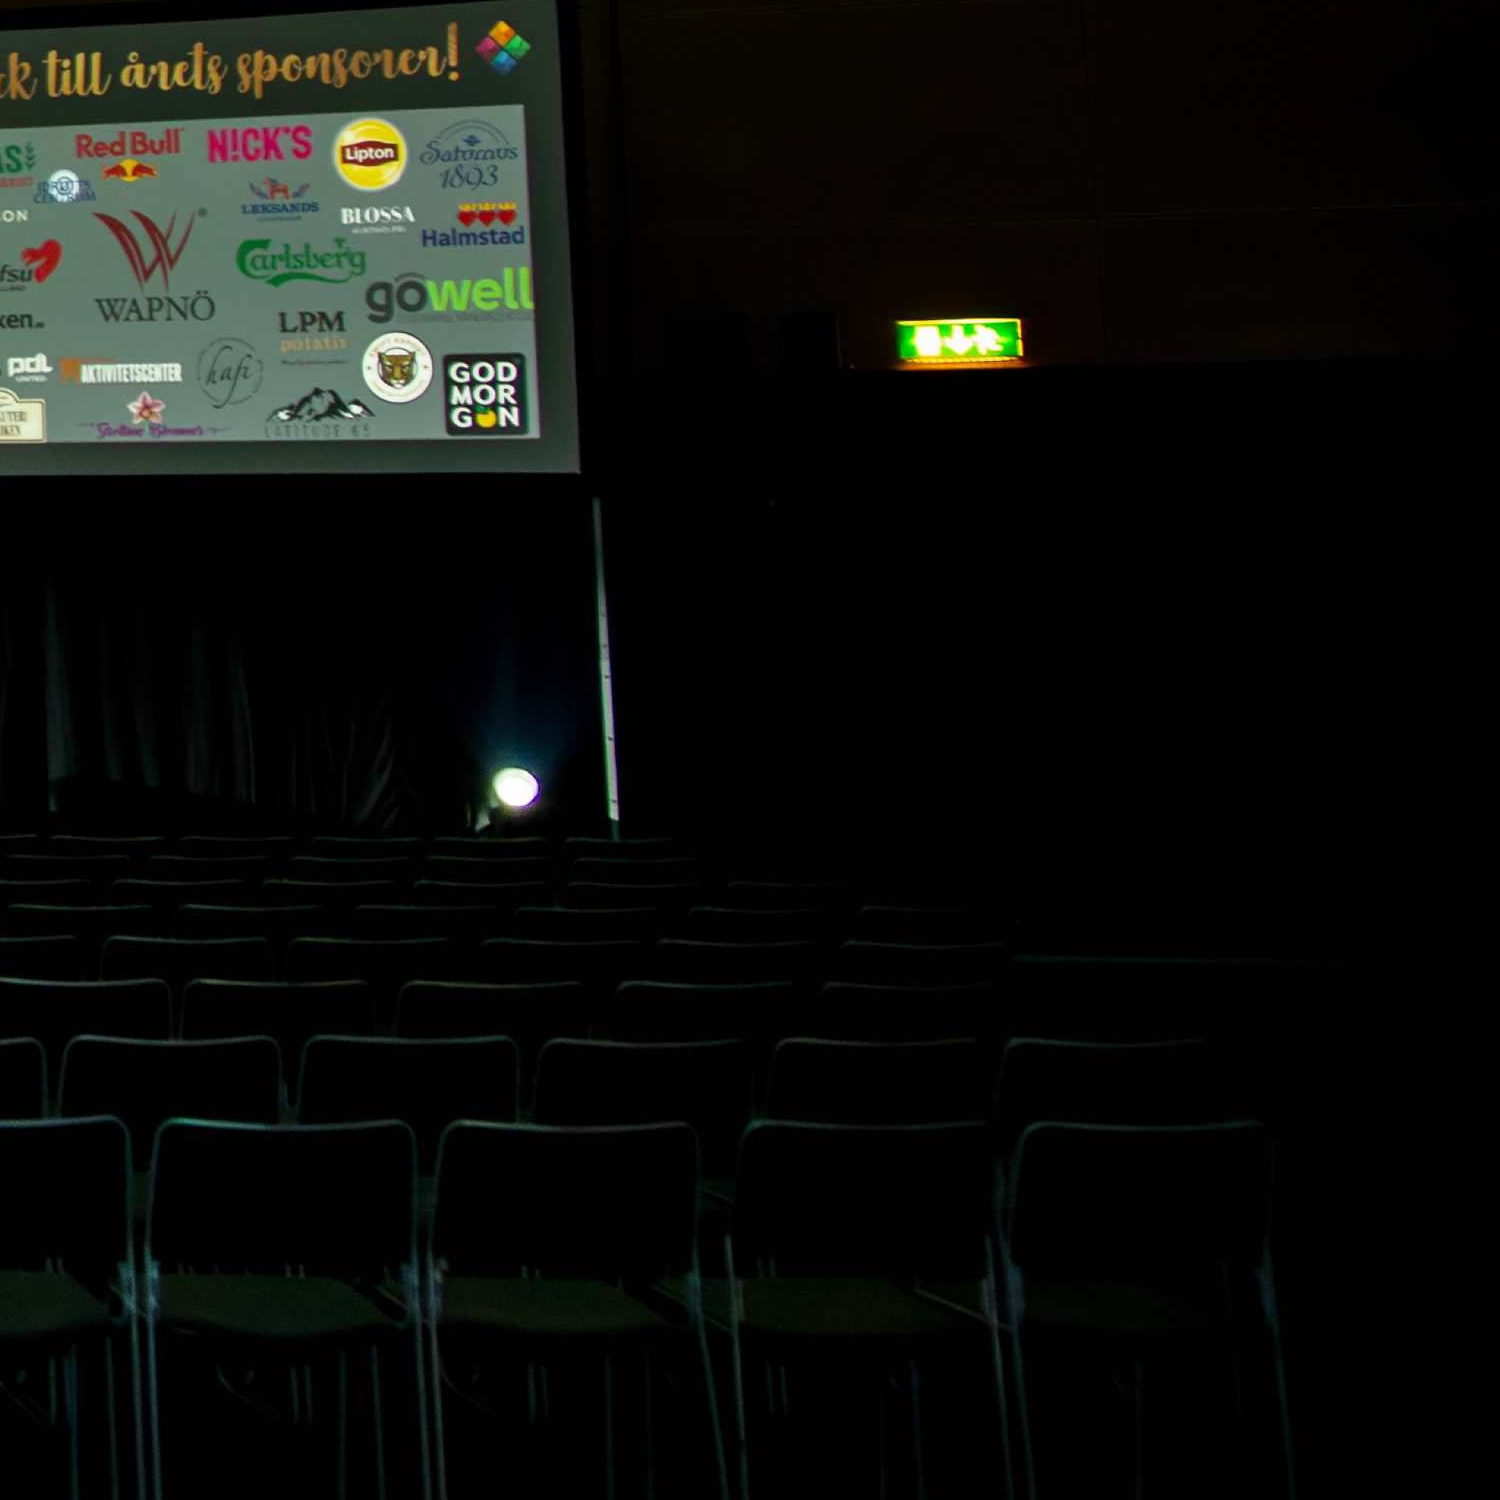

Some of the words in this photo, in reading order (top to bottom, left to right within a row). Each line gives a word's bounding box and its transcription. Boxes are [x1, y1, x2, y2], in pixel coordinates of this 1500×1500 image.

[42, 50, 111, 97] till
[121, 42, 228, 94] årets
[237, 22, 459, 99] sponsorer!
[75, 131, 126, 158] Red
[130, 128, 180, 156] Bull
[344, 147, 395, 163] Lipton
[440, 164, 499, 190] 1893
[241, 202, 319, 215] LEKSANDS
[340, 206, 415, 225] BLOSSA
[422, 226, 525, 247] Halmstad
[236, 237, 366, 287] Carlsberg
[95, 290, 216, 322] WAPNÖ
[365, 267, 534, 324] gowell
[278, 311, 346, 333] LPM
[81, 363, 183, 384] AKTIVITETSCENTER
[448, 362, 518, 383] GOD
[451, 384, 518, 406] MOR
